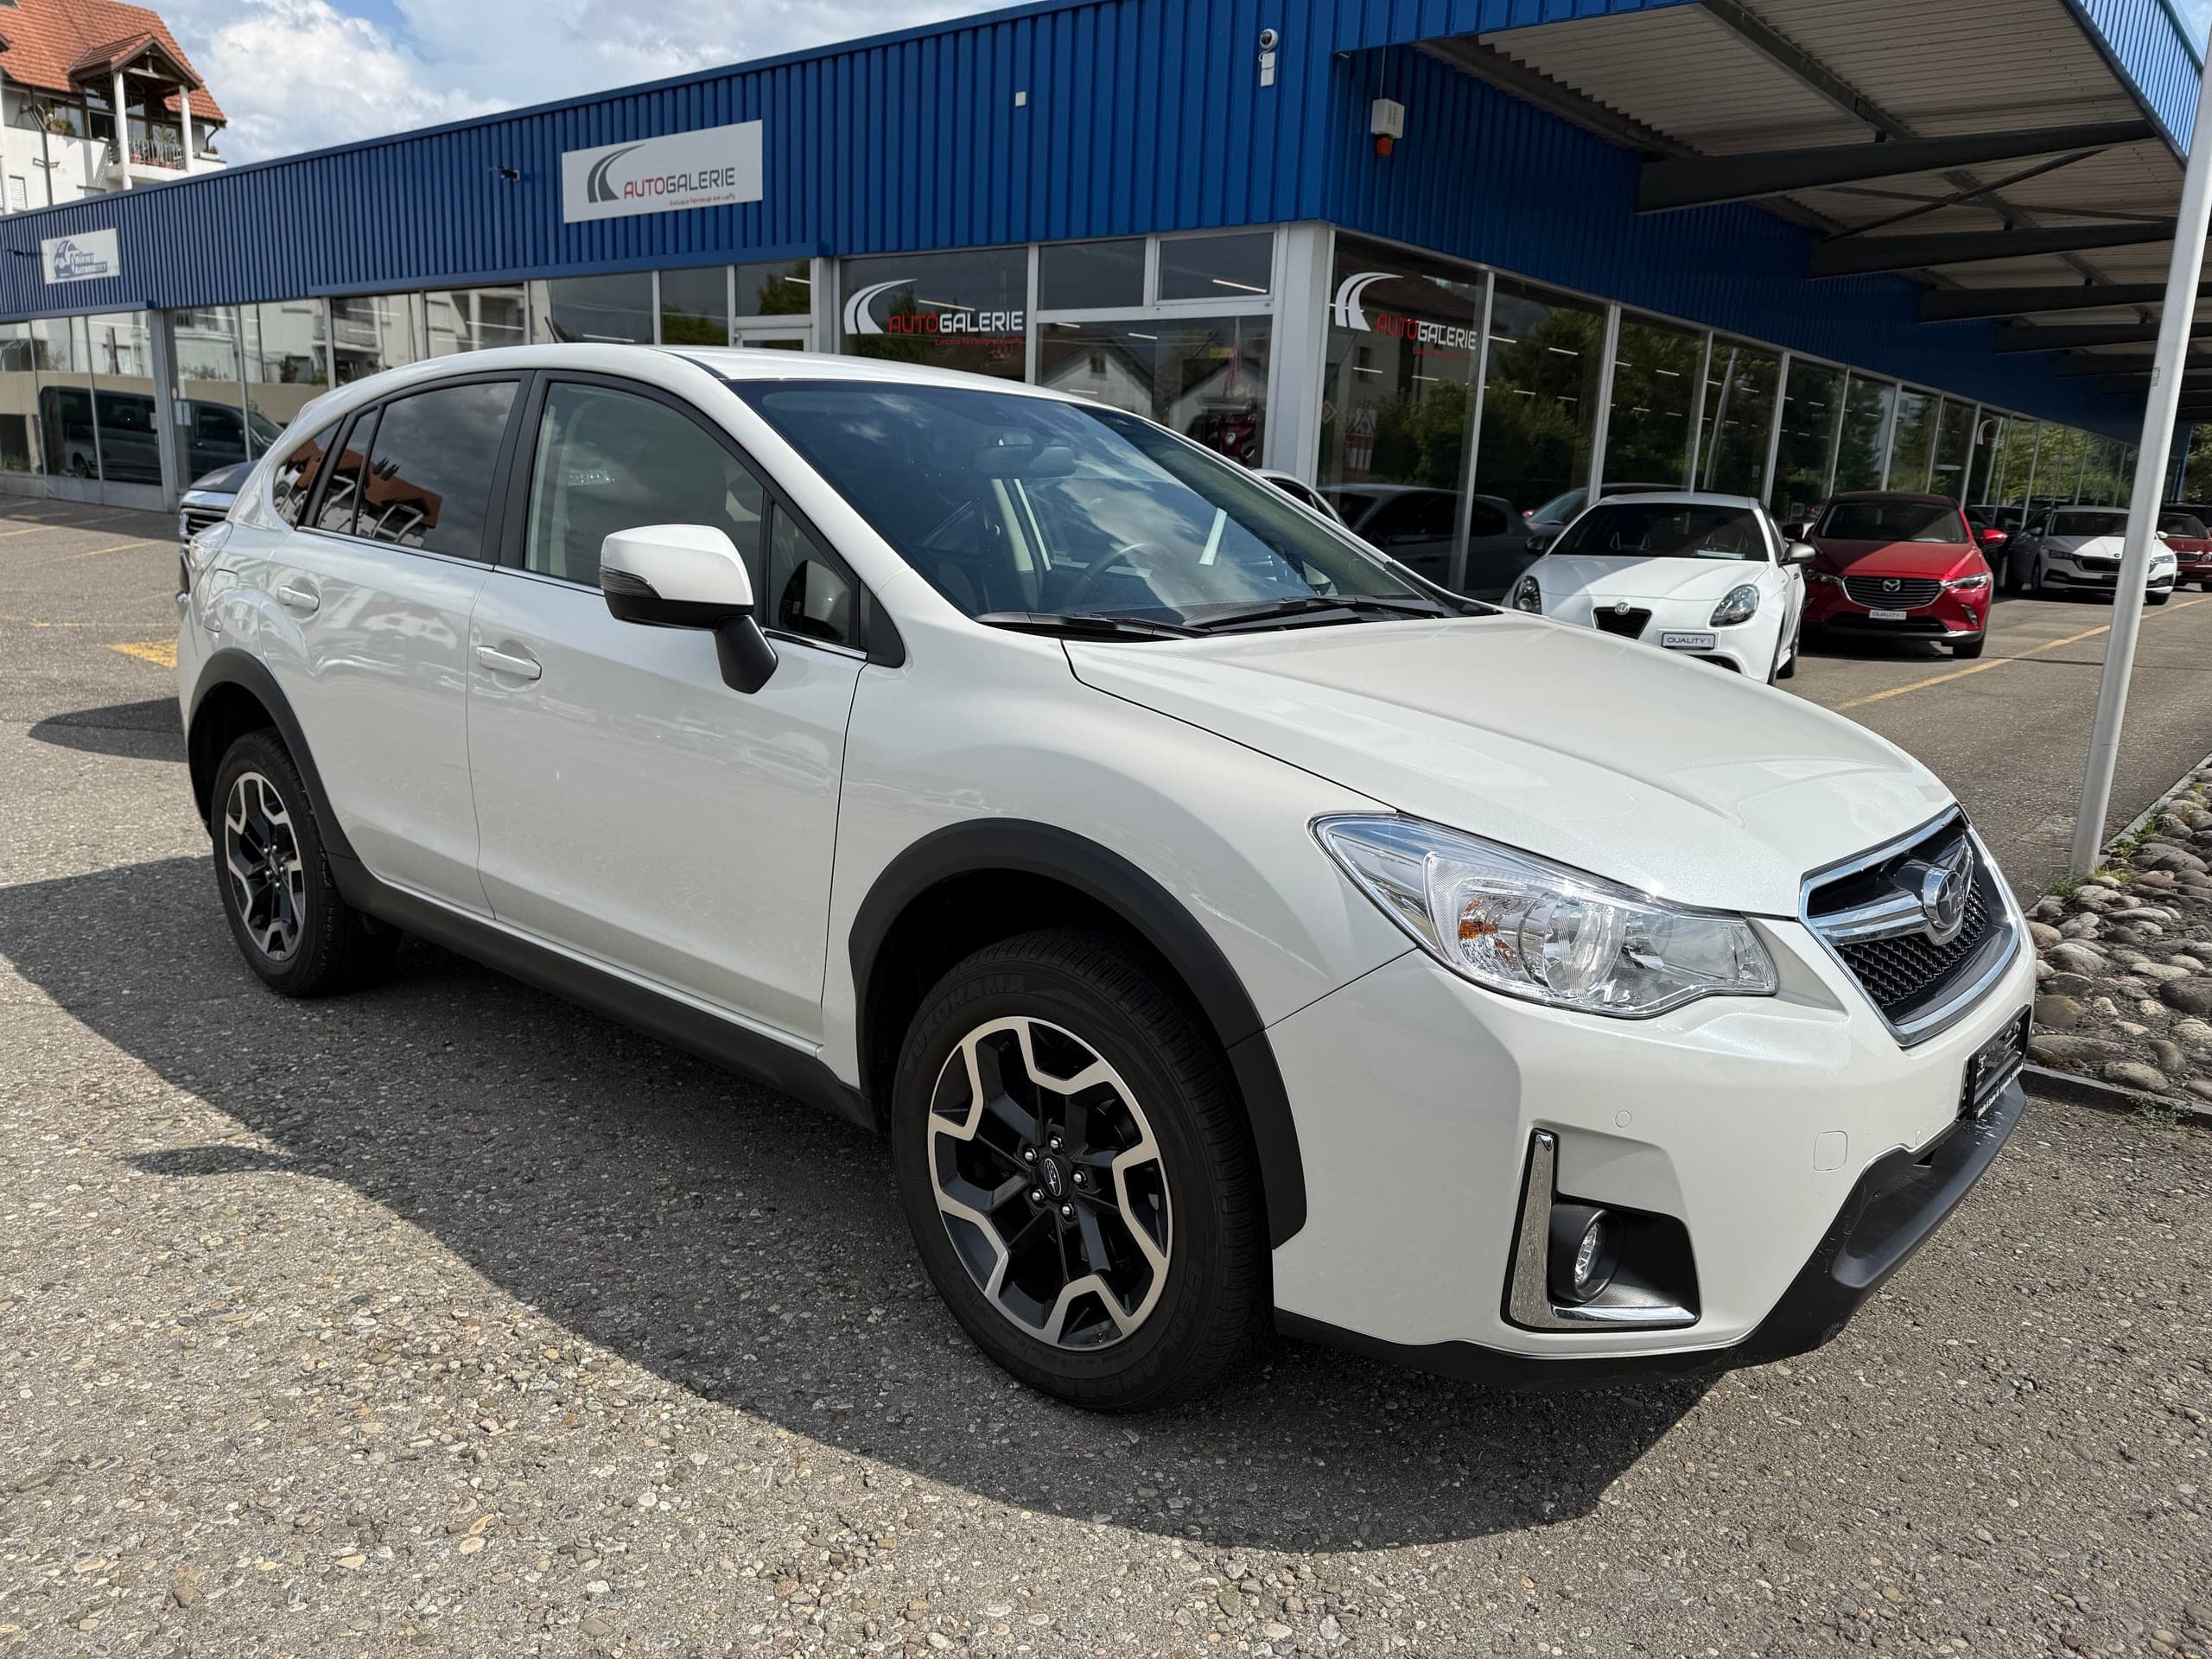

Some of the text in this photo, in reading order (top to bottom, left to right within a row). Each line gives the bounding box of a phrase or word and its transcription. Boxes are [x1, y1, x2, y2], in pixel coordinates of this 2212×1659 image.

[624, 167, 735, 200] AUTOGALERIE
[887, 310, 1024, 334] AUTOGALERIE
[1375, 312, 1478, 351] AUTOGALERIE
